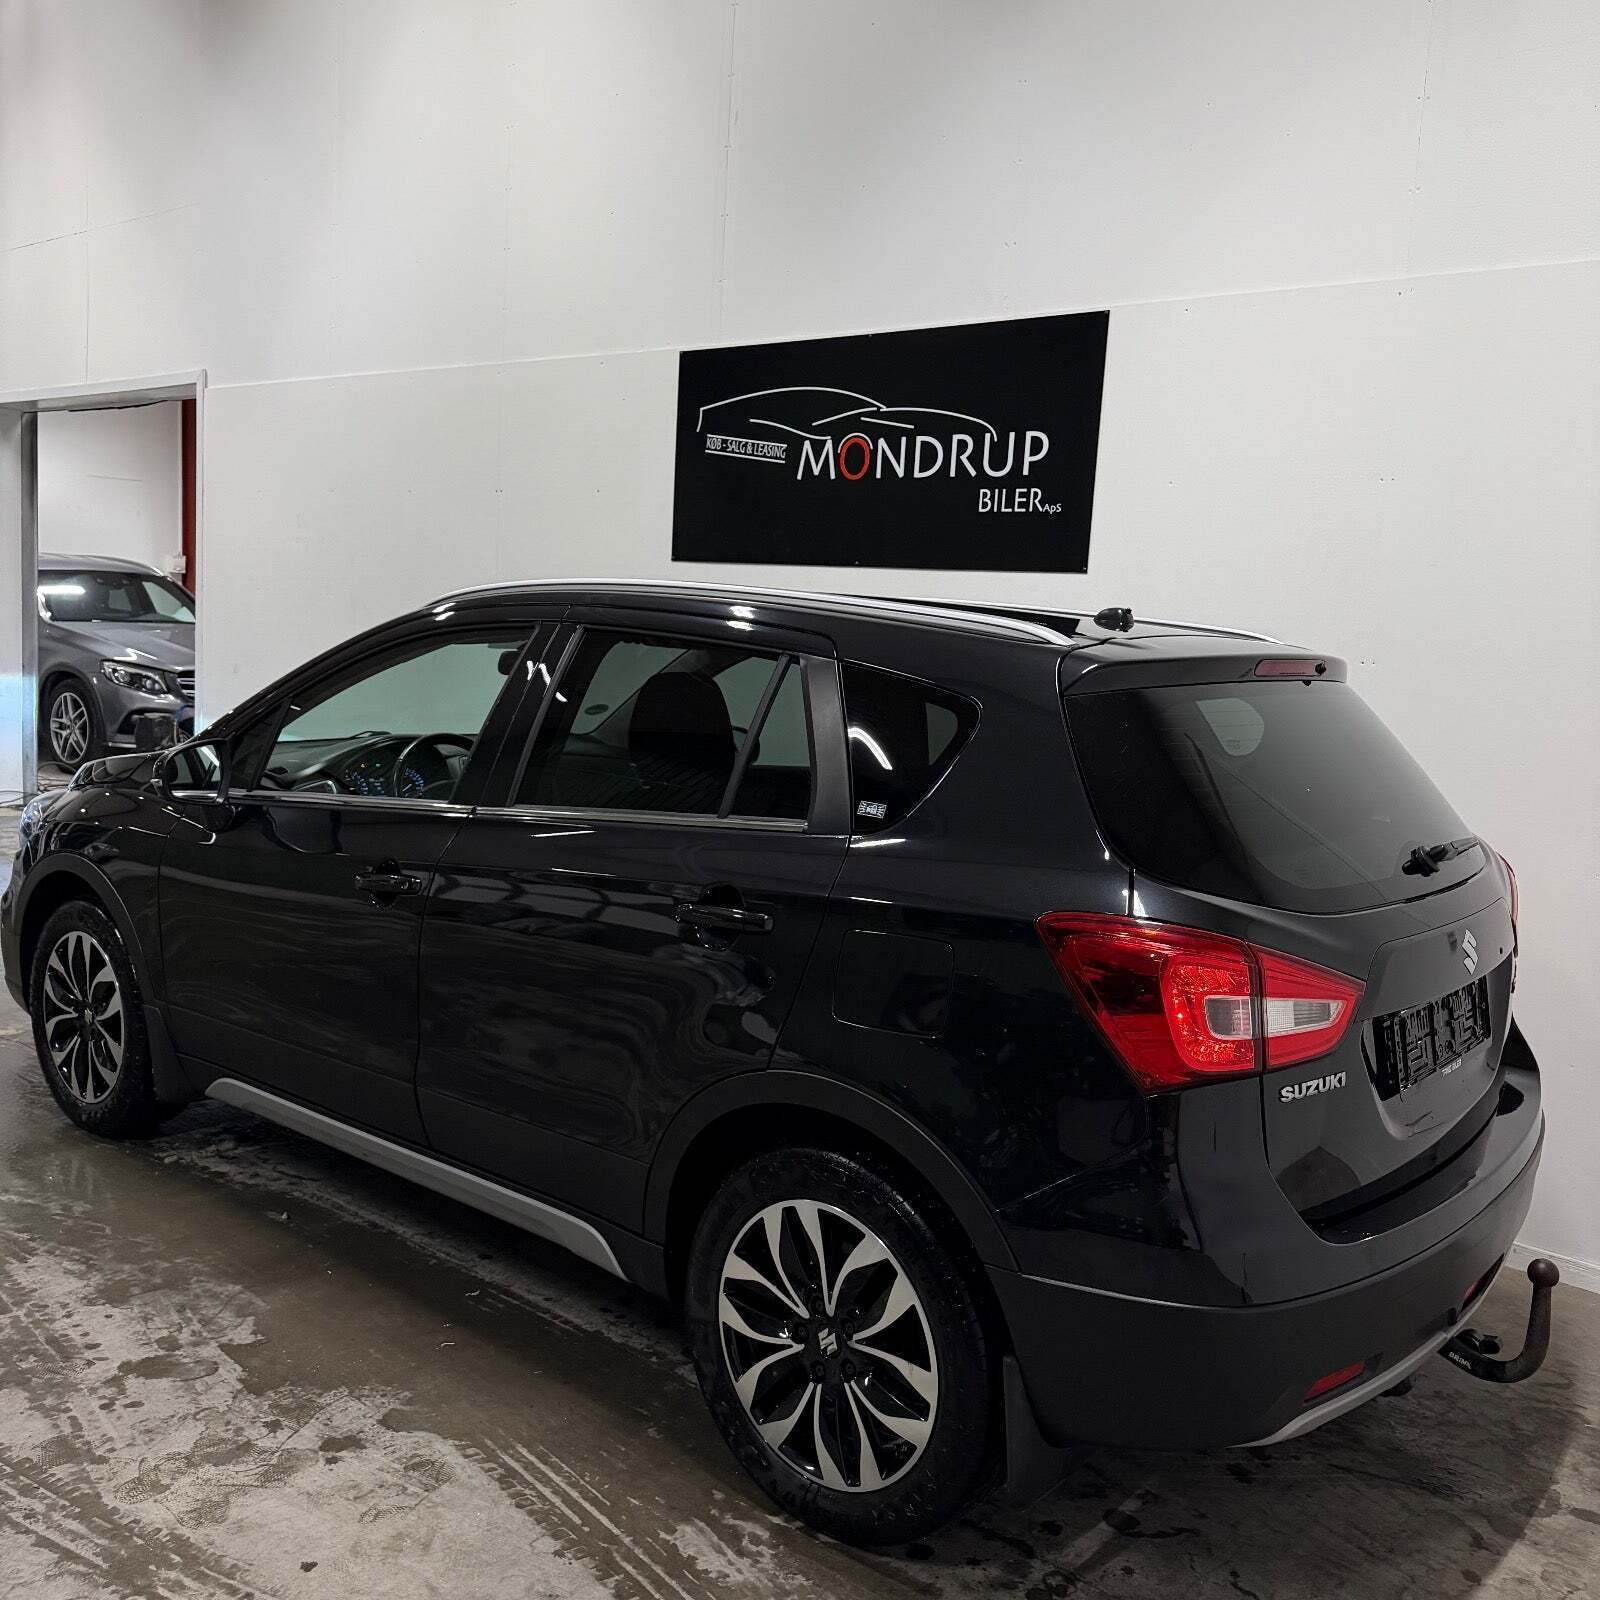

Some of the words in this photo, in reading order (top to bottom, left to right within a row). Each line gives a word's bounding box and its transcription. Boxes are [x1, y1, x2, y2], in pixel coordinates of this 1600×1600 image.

[706, 437, 722, 450] KØB
[726, 440, 746, 453] SALG
[746, 442, 753, 454] &
[754, 443, 787, 458] LEASING
[796, 430, 1050, 481] MONDRUP
[978, 487, 1043, 513] BILER
[1042, 503, 1062, 515] ApS
[1280, 1071, 1346, 1103] SUZUKI
